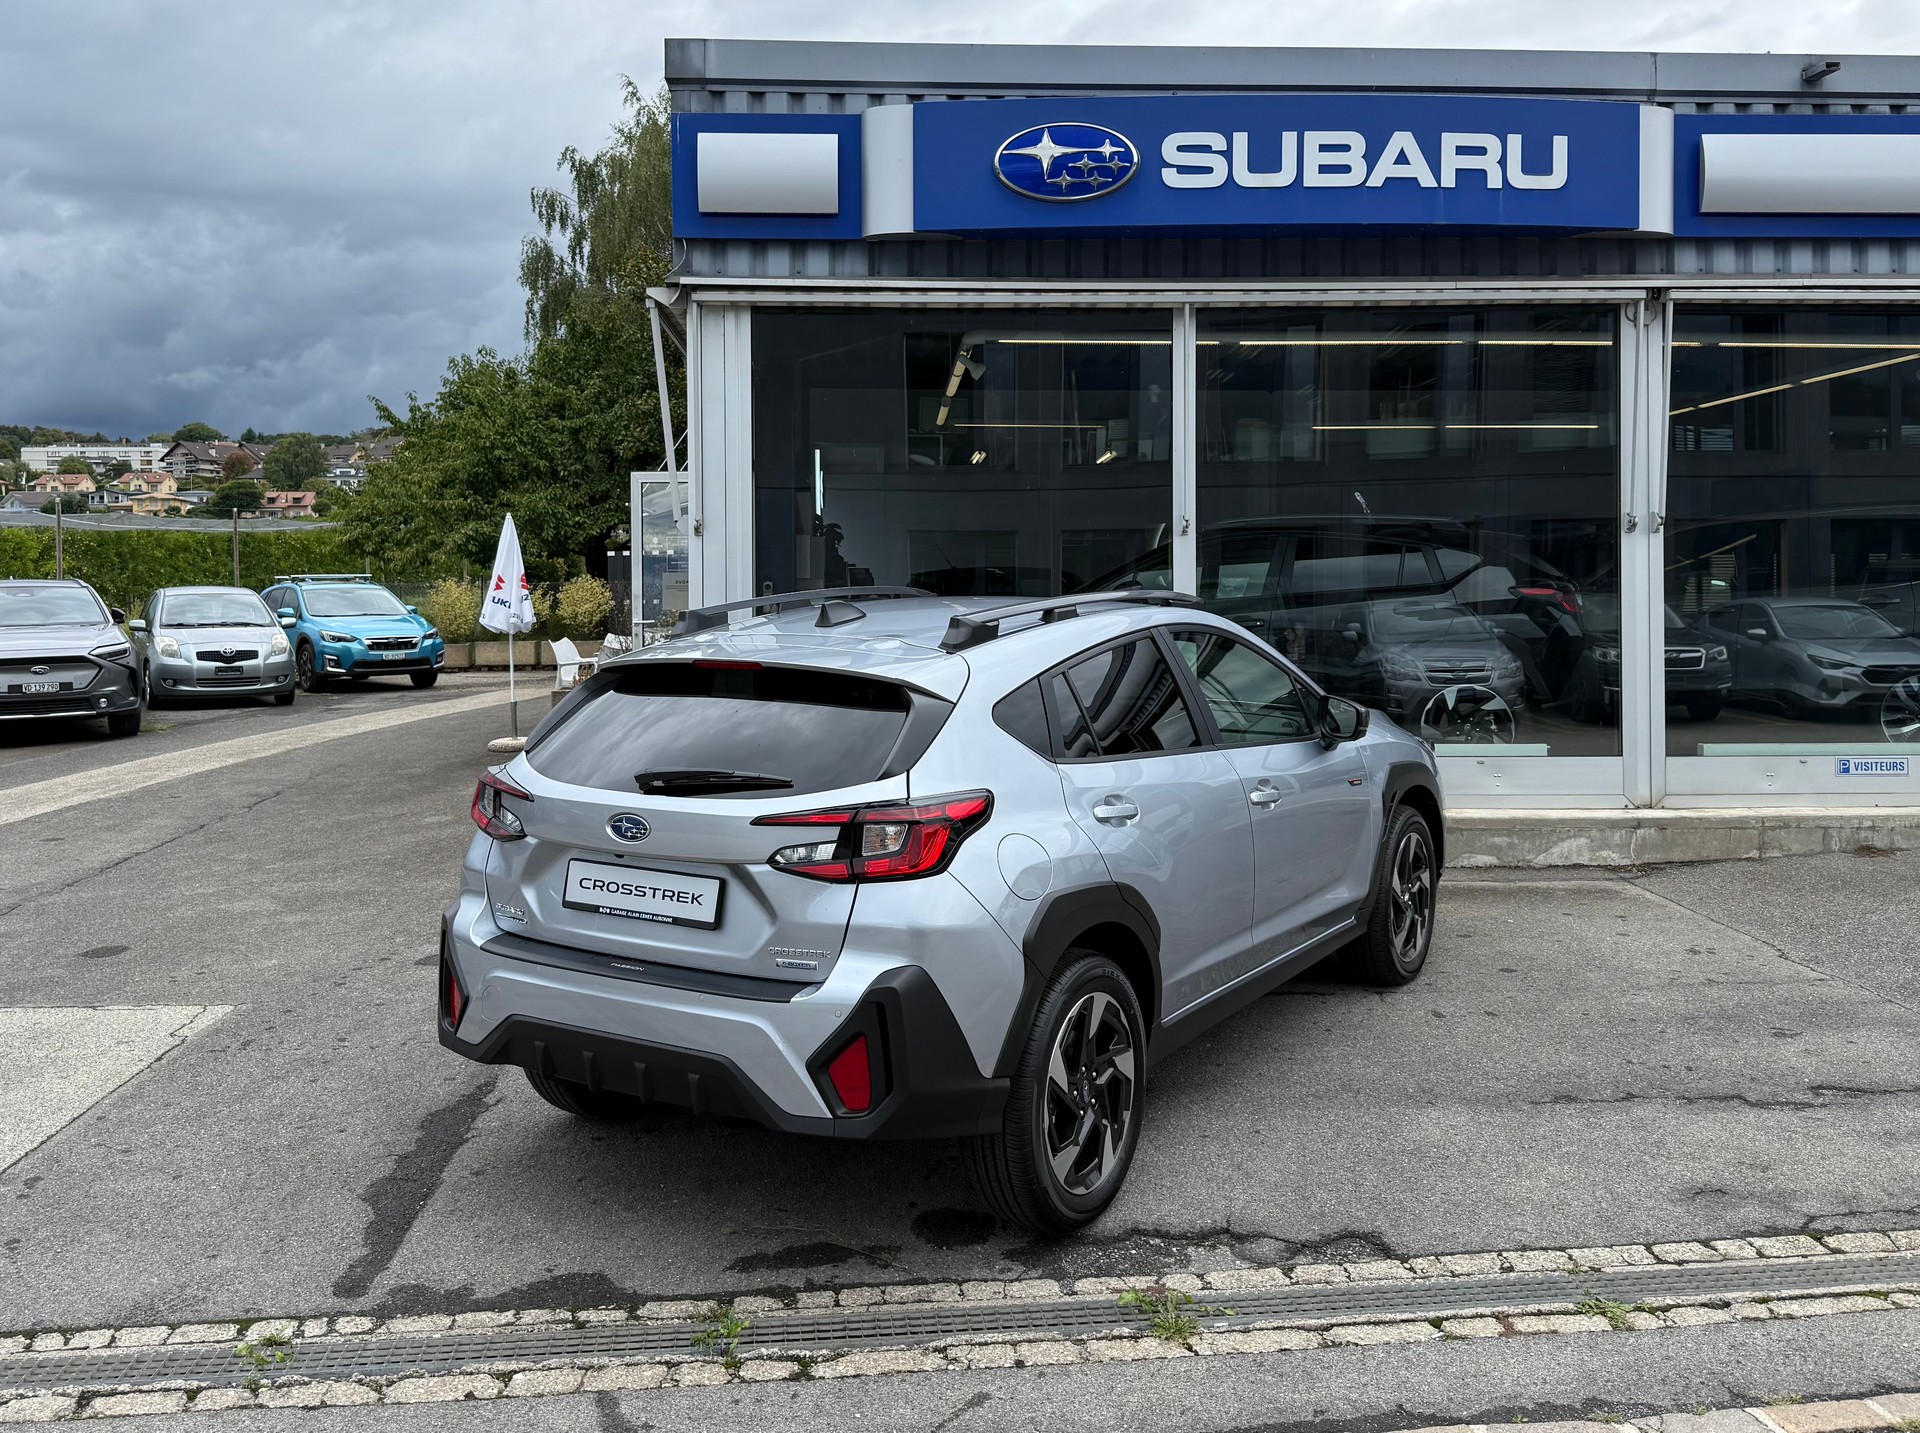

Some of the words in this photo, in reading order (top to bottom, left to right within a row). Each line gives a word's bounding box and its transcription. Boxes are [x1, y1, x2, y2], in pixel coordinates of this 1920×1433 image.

[1160, 130, 1569, 190] SUBARU
[1853, 761, 1905, 771] VISITEURS
[579, 877, 704, 906] CROSSTREK
[611, 908, 627, 916] GARAGE
[768, 946, 831, 959] CROSSTREK
